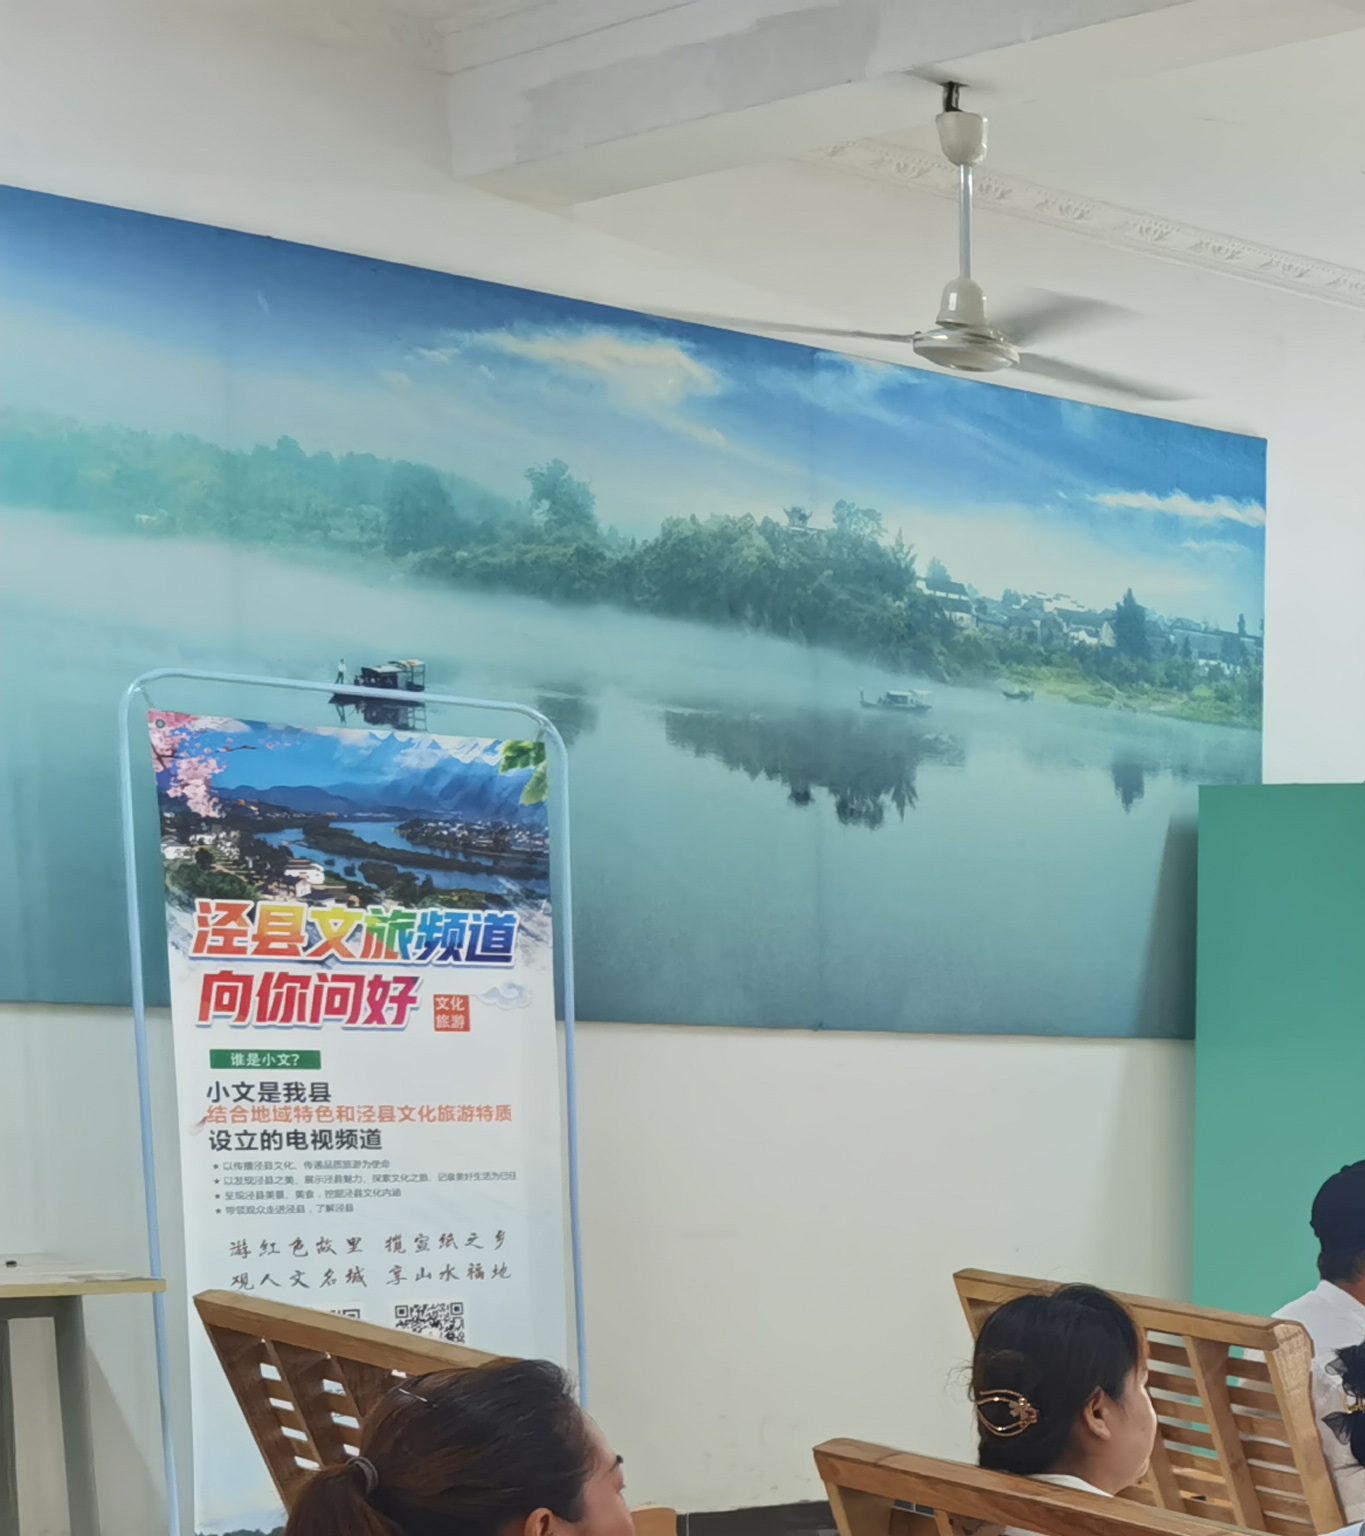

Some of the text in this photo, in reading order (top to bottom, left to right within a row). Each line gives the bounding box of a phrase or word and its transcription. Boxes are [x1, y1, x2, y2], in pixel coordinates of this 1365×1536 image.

[191, 900, 518, 963] 泾县文旅频道
[196, 971, 421, 1026] 向你问好
[435, 996, 465, 1012] 文化
[436, 1014, 466, 1029] 旅游
[206, 1081, 332, 1104] 小文是我县
[206, 1104, 513, 1124] 结合地域特色和泾县文化旅游特质
[209, 1129, 383, 1151] 设立的电视频道
